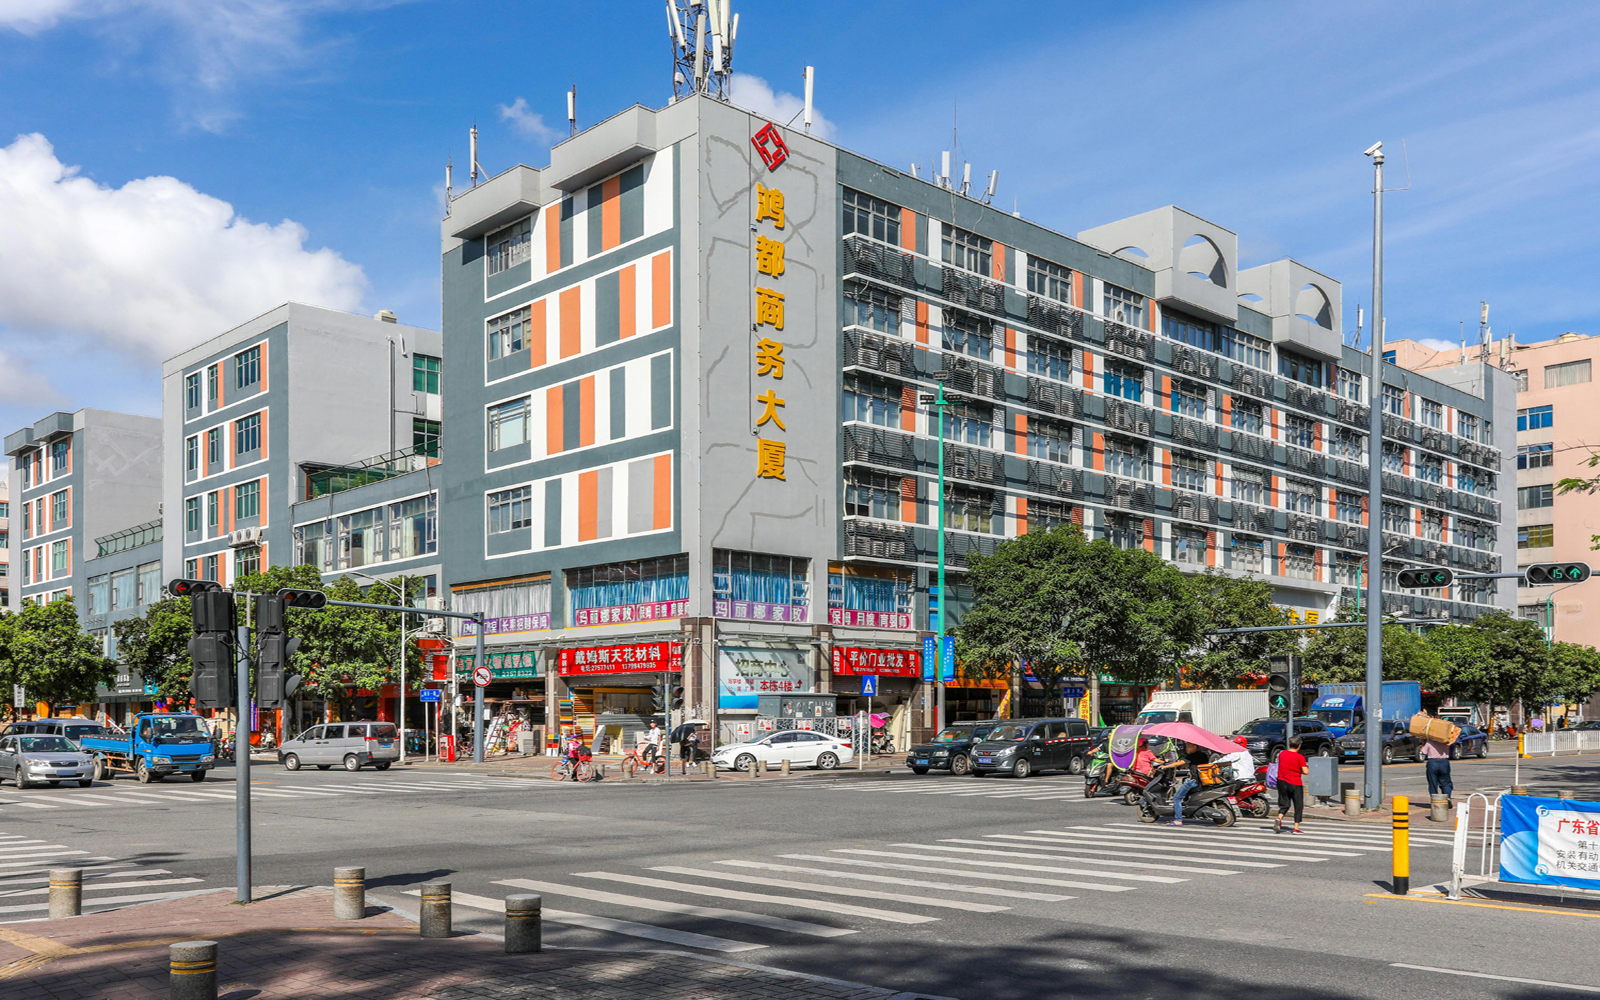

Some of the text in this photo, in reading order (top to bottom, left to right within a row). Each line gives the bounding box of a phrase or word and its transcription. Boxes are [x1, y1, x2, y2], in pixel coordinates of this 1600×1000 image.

[755, 183, 786, 481] 鸿都商务大厦
[1420, 573, 1430, 583] 15
[1552, 568, 1563, 579] 15
[579, 607, 632, 625] 玛丽娜家政
[715, 601, 803, 622] 玛丽娜家政
[502, 615, 547, 632] 长期招聘保姆
[575, 645, 661, 665] 戴姆斯天花材料
[849, 651, 904, 668] 平价门业批发
[735, 659, 791, 678] 招商中心
[760, 680, 793, 692] 本栋4楼
[1557, 818, 1600, 836] 广东省
[1577, 840, 1599, 850] 第十
[1556, 849, 1599, 861] 安装有动
[1556, 860, 1599, 873] 机关交通
